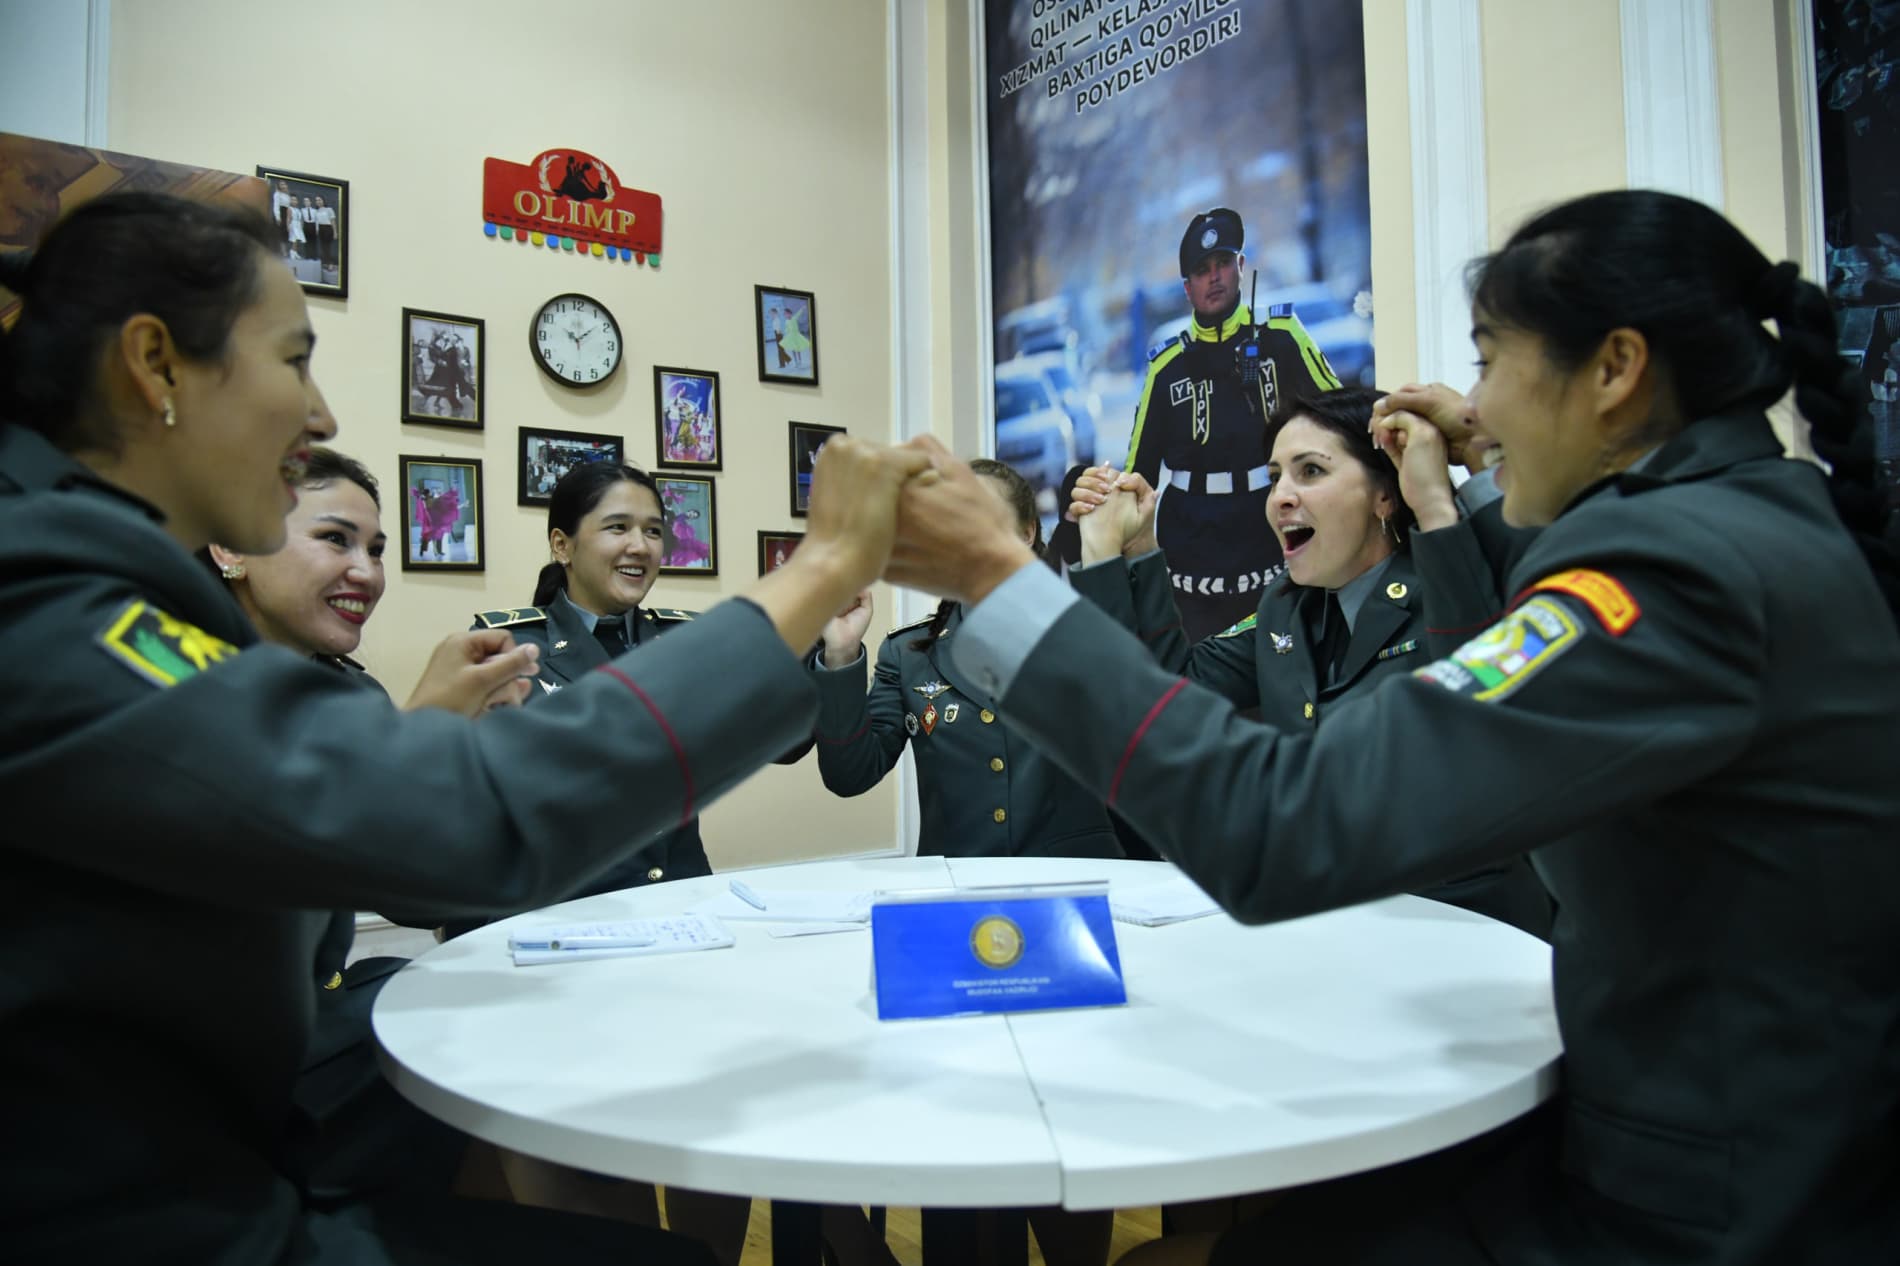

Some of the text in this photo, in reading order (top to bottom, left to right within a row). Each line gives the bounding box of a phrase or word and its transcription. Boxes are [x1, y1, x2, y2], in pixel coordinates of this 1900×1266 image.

[1047, 37, 1133, 97] BAXTIGA
[1076, 11, 1239, 112] POYDEVORDIR!
[1000, 42, 1067, 95] XIZMAT
[513, 190, 636, 235] OLIMP
[556, 303, 565, 313] 11
[572, 300, 585, 312] 12
[543, 313, 554, 324] 10
[592, 309, 598, 319] 1
[602, 322, 610, 333] 2
[539, 330, 546, 341] 9
[607, 341, 615, 351] 3
[544, 349, 551, 360] 8
[602, 357, 610, 368] 4
[556, 363, 564, 374] 7
[590, 368, 599, 379] 5
[573, 370, 581, 381] 6
